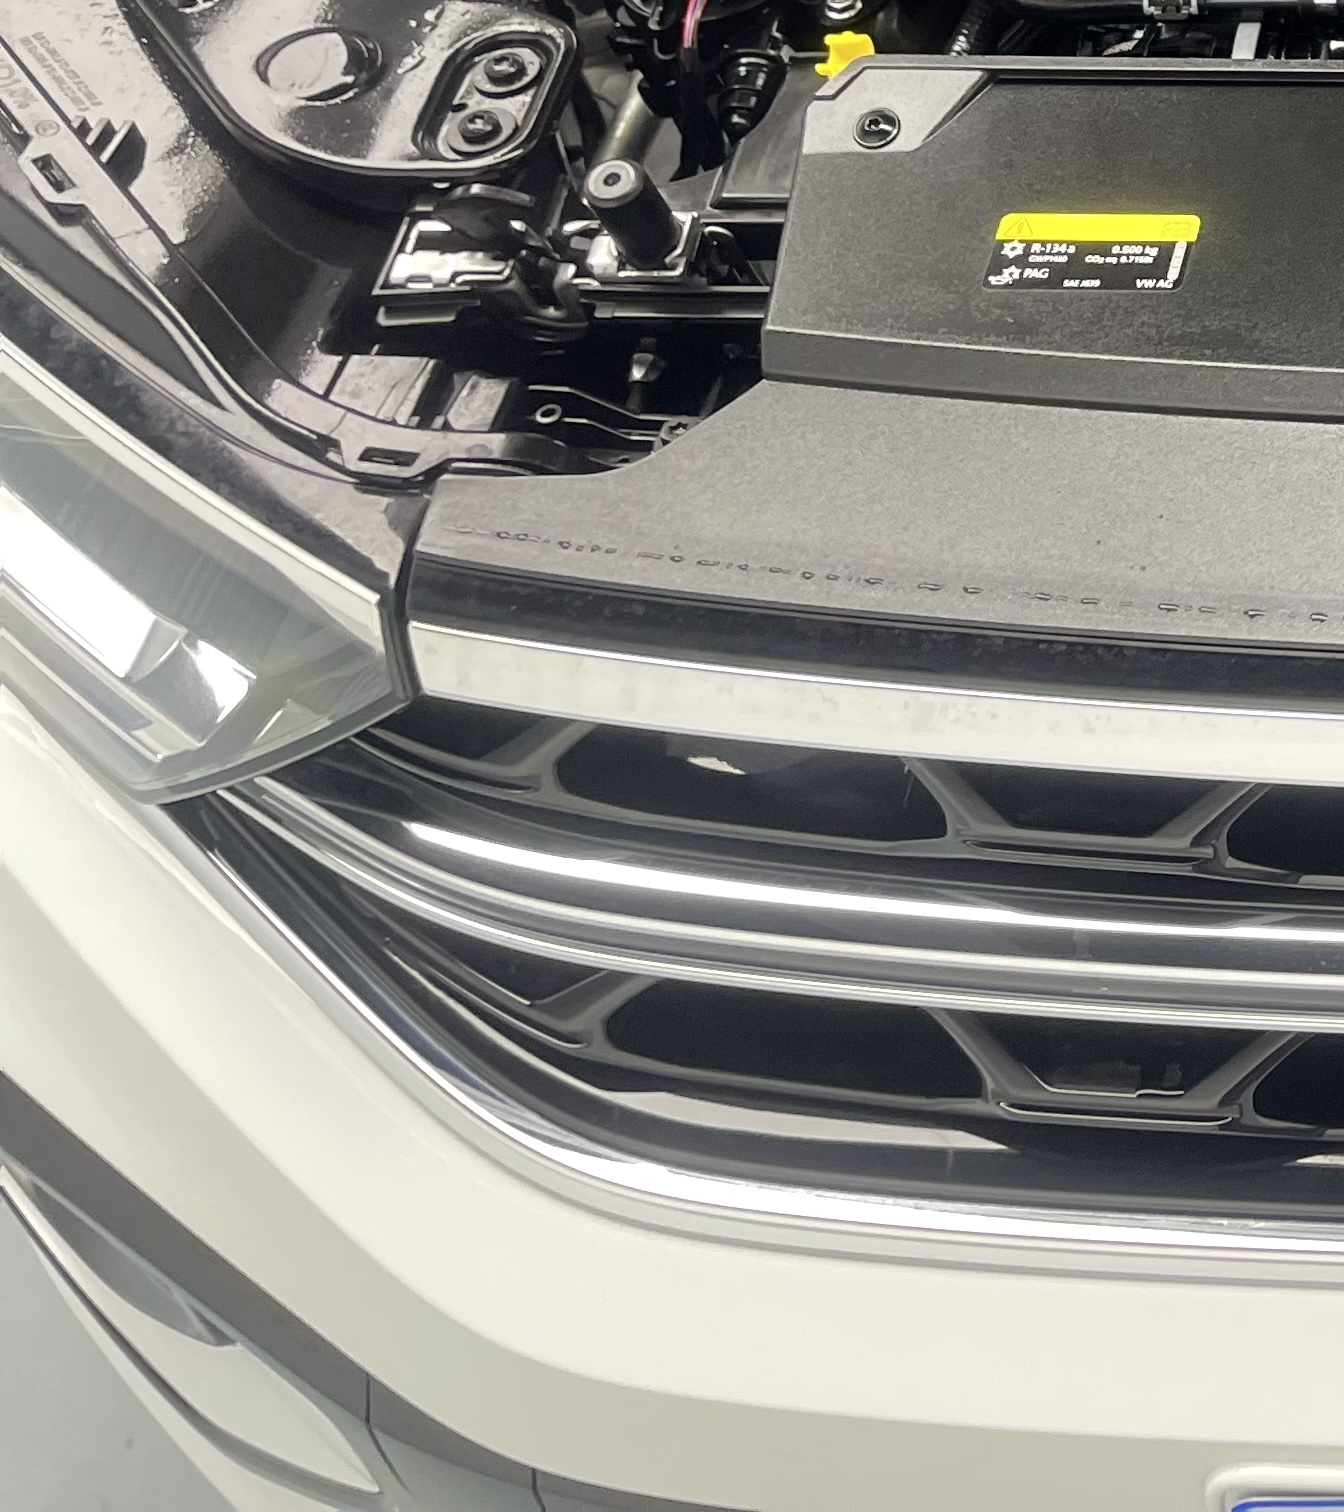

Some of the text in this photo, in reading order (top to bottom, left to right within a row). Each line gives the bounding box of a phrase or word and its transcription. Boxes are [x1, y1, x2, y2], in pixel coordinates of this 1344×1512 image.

[1144, 244, 1159, 257] kg
[1022, 268, 1050, 279] PAG
[1136, 279, 1174, 289] VW AG
